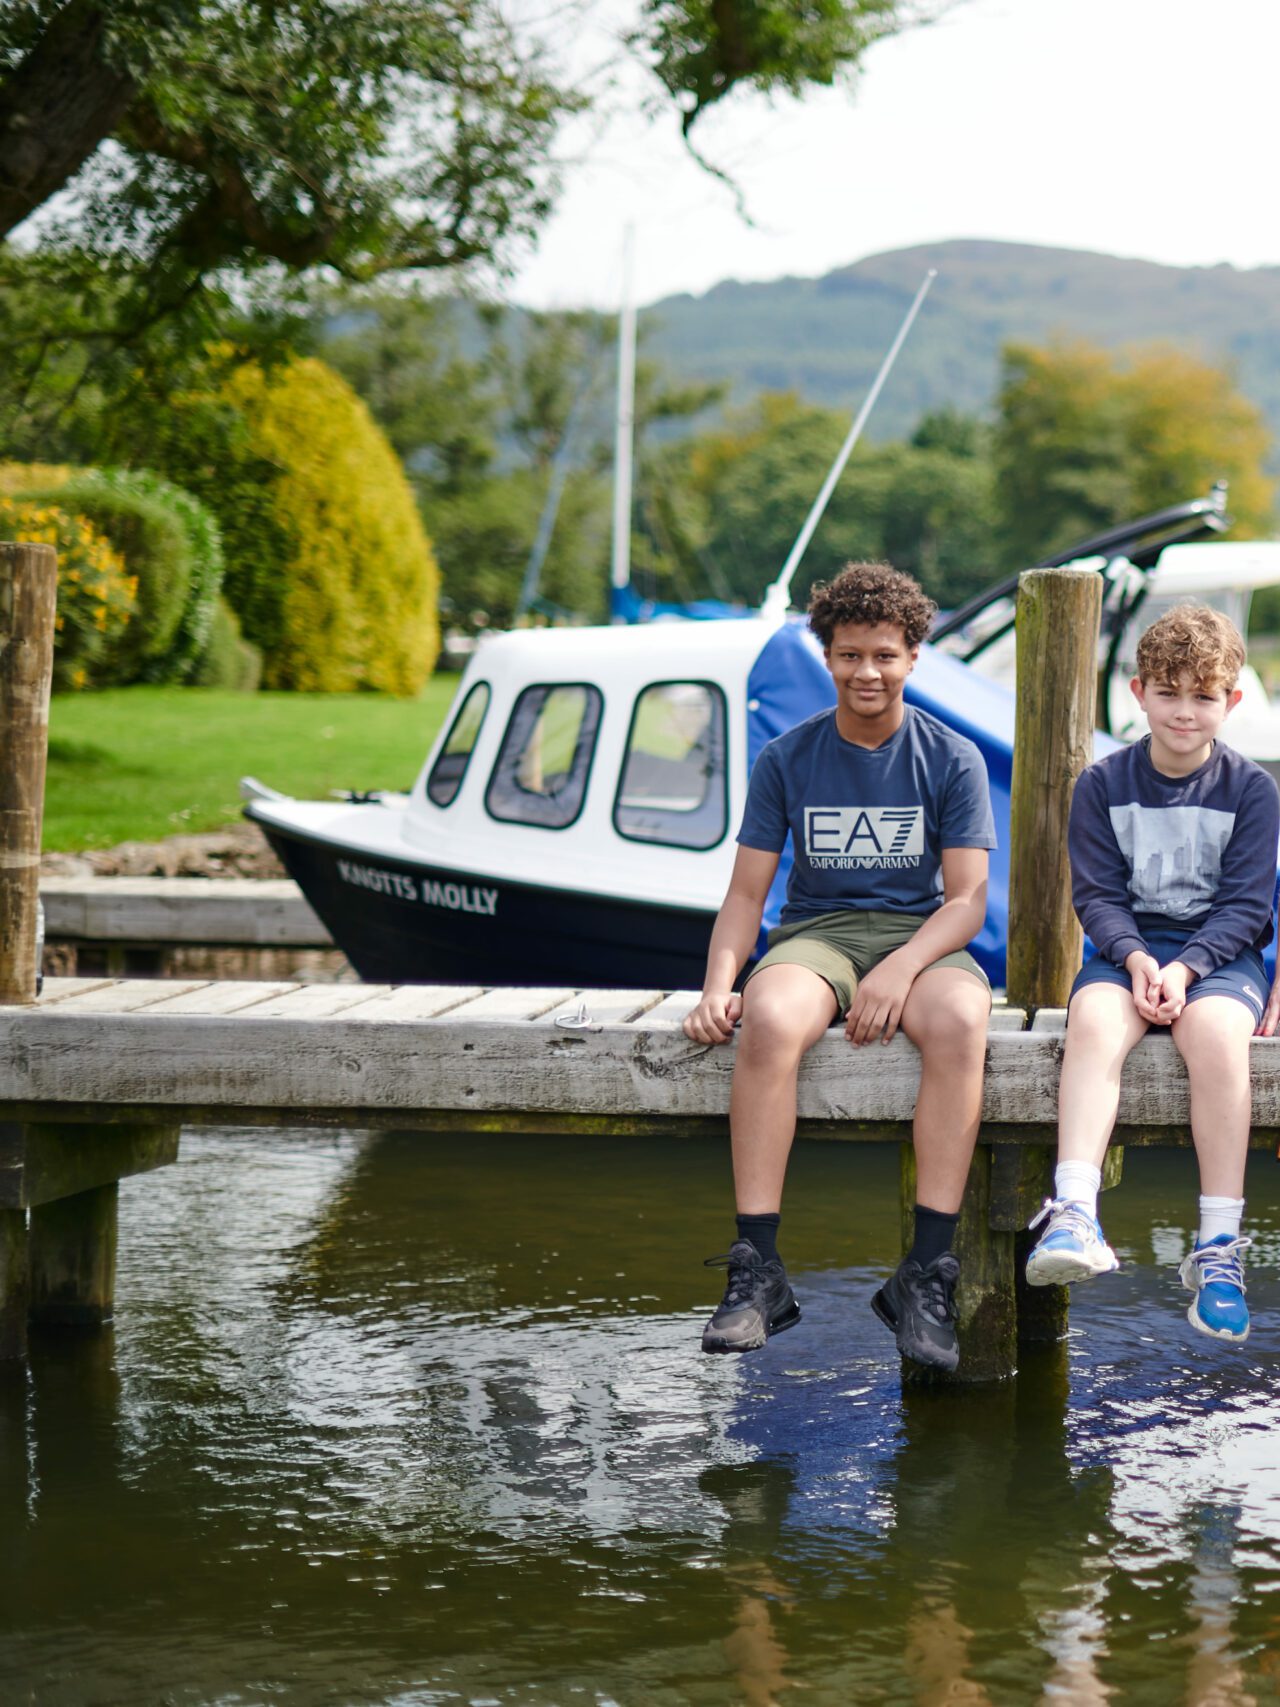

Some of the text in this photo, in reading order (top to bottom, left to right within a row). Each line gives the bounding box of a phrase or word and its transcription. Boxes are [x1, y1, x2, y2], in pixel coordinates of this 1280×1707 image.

[809, 811, 919, 853] EA7
[809, 856, 920, 869] EMPORIO ARMANI
[337, 859, 498, 915] KNOTTS MOLLY
